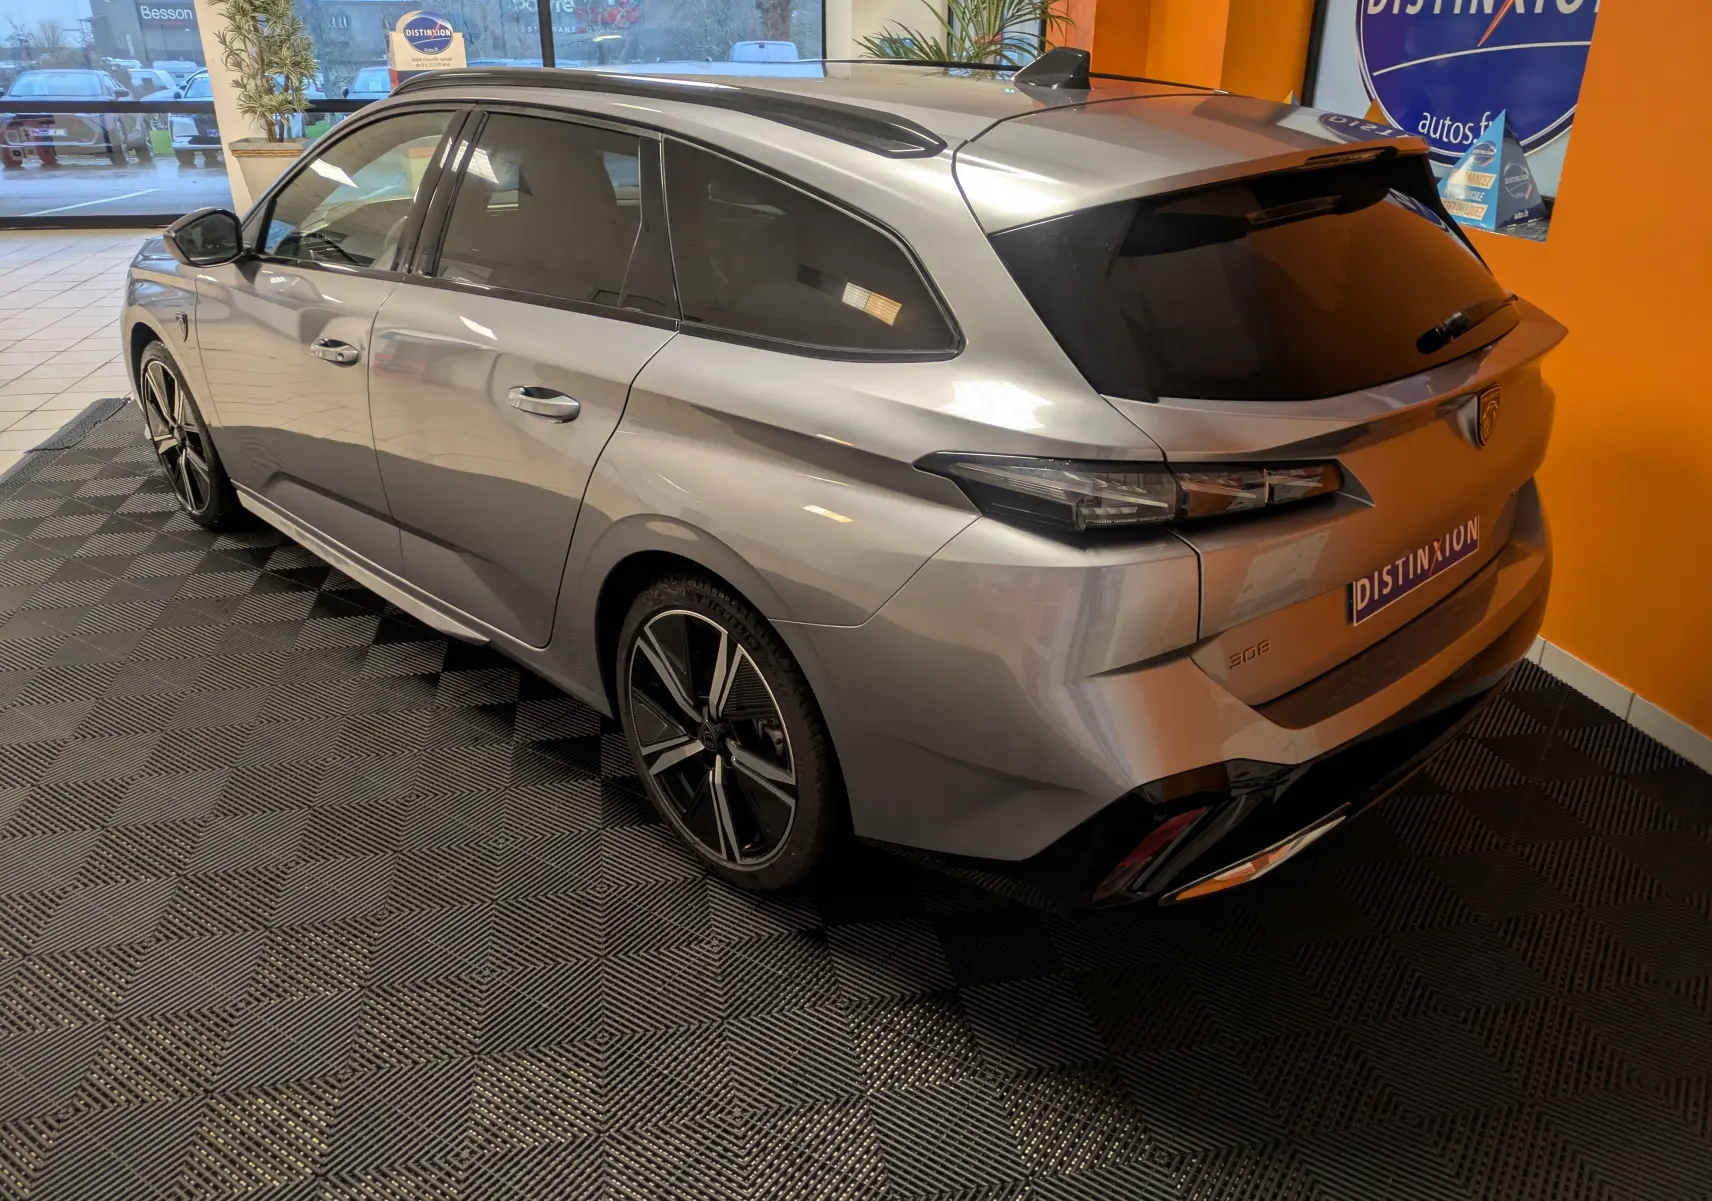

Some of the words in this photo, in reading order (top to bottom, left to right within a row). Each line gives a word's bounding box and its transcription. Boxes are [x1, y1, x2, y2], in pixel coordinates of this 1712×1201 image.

[140, 5, 193, 20] Besson
[405, 29, 451, 37] DISTINXION
[1418, 111, 1493, 144] autos.f
[1356, 516, 1479, 611] DISTINXION
[1229, 639, 1271, 670] 308
